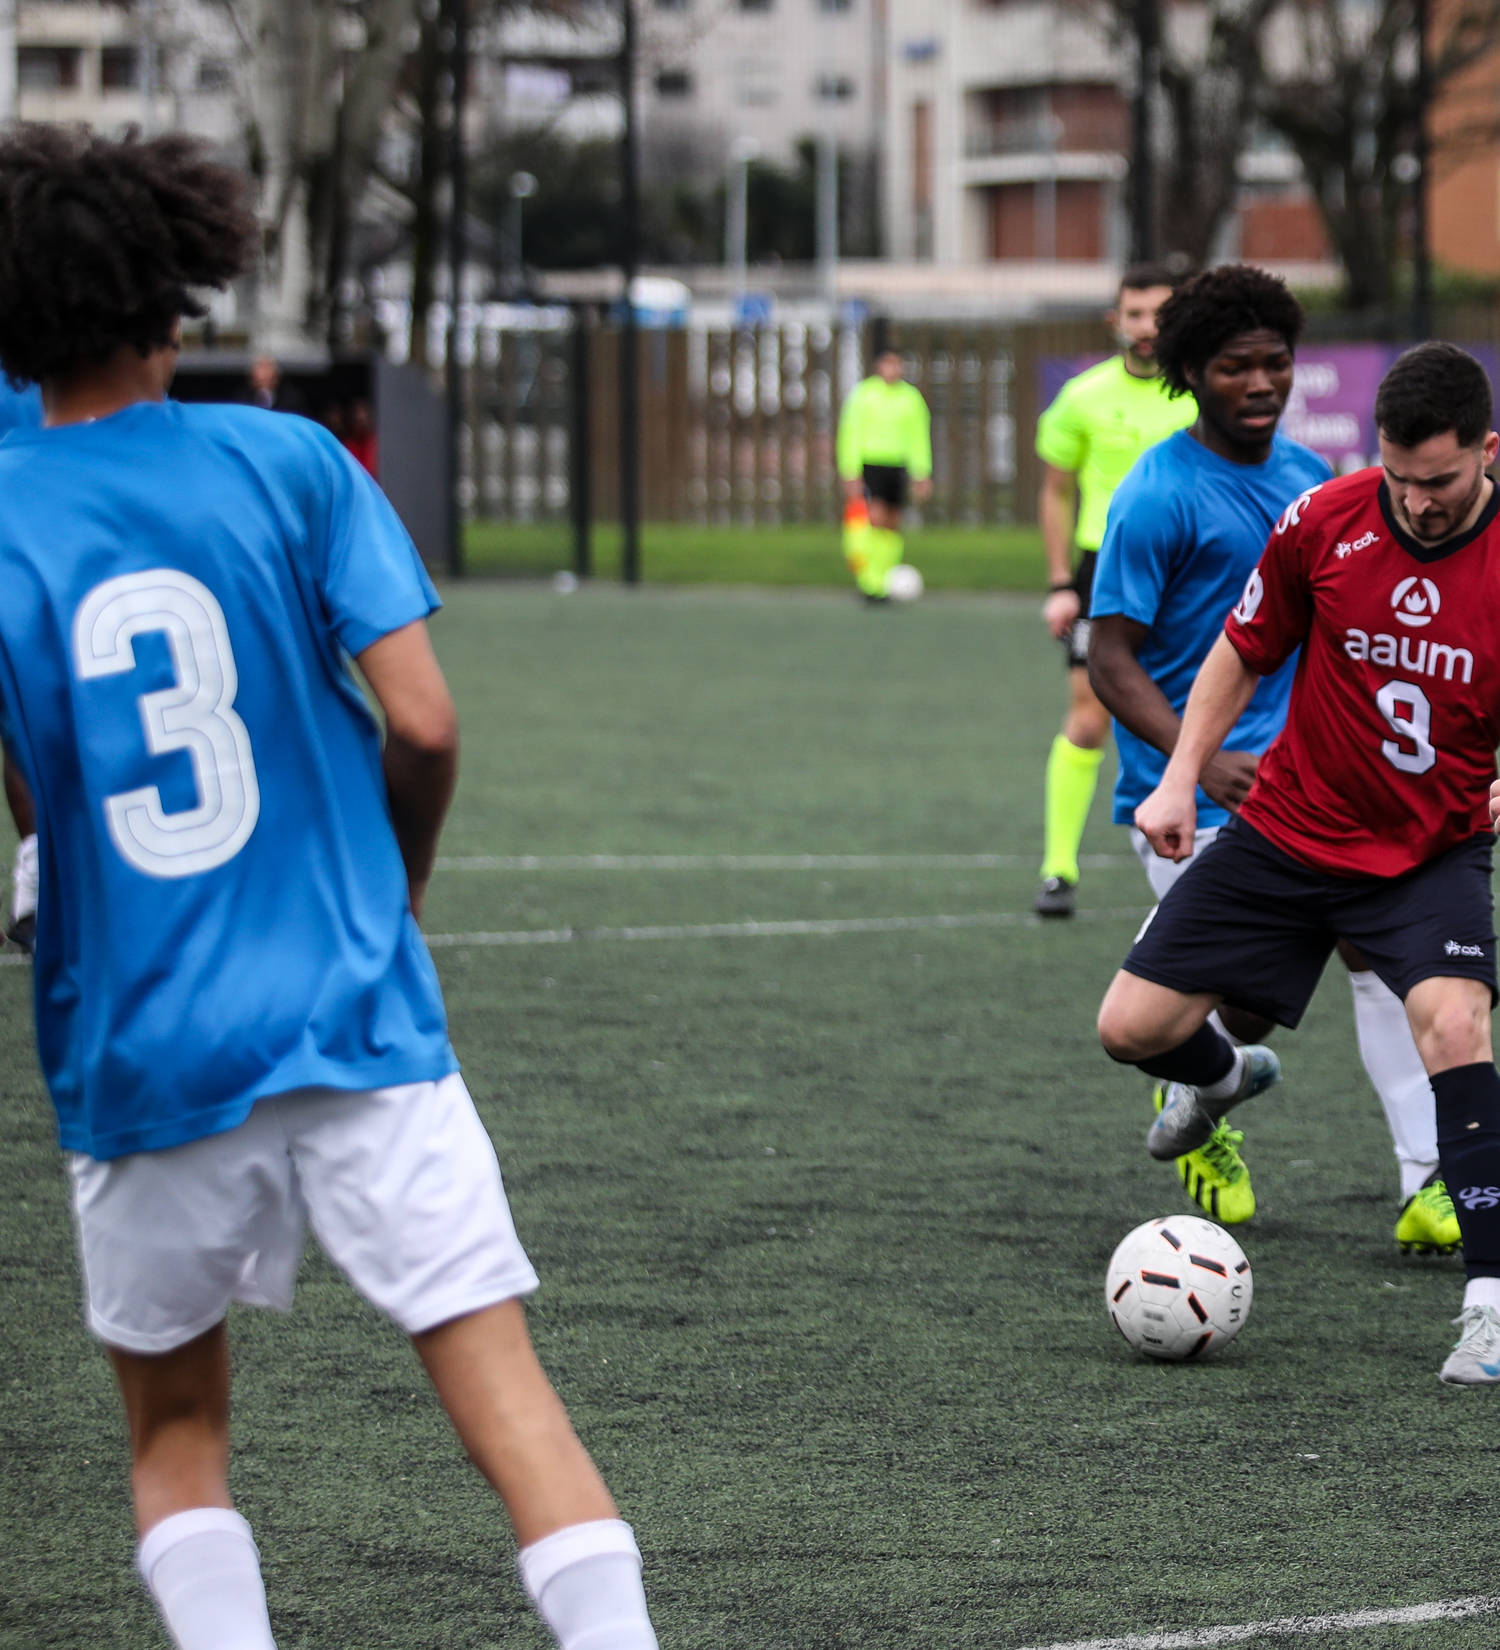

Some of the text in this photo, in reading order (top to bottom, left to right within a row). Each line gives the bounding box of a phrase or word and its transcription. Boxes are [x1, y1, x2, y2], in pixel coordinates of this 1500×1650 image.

[1352, 530, 1380, 551] cdt
[1231, 567, 1264, 625] 9
[1343, 628, 1474, 684] aaum
[73, 568, 260, 877] 3
[1375, 678, 1437, 775] 9
